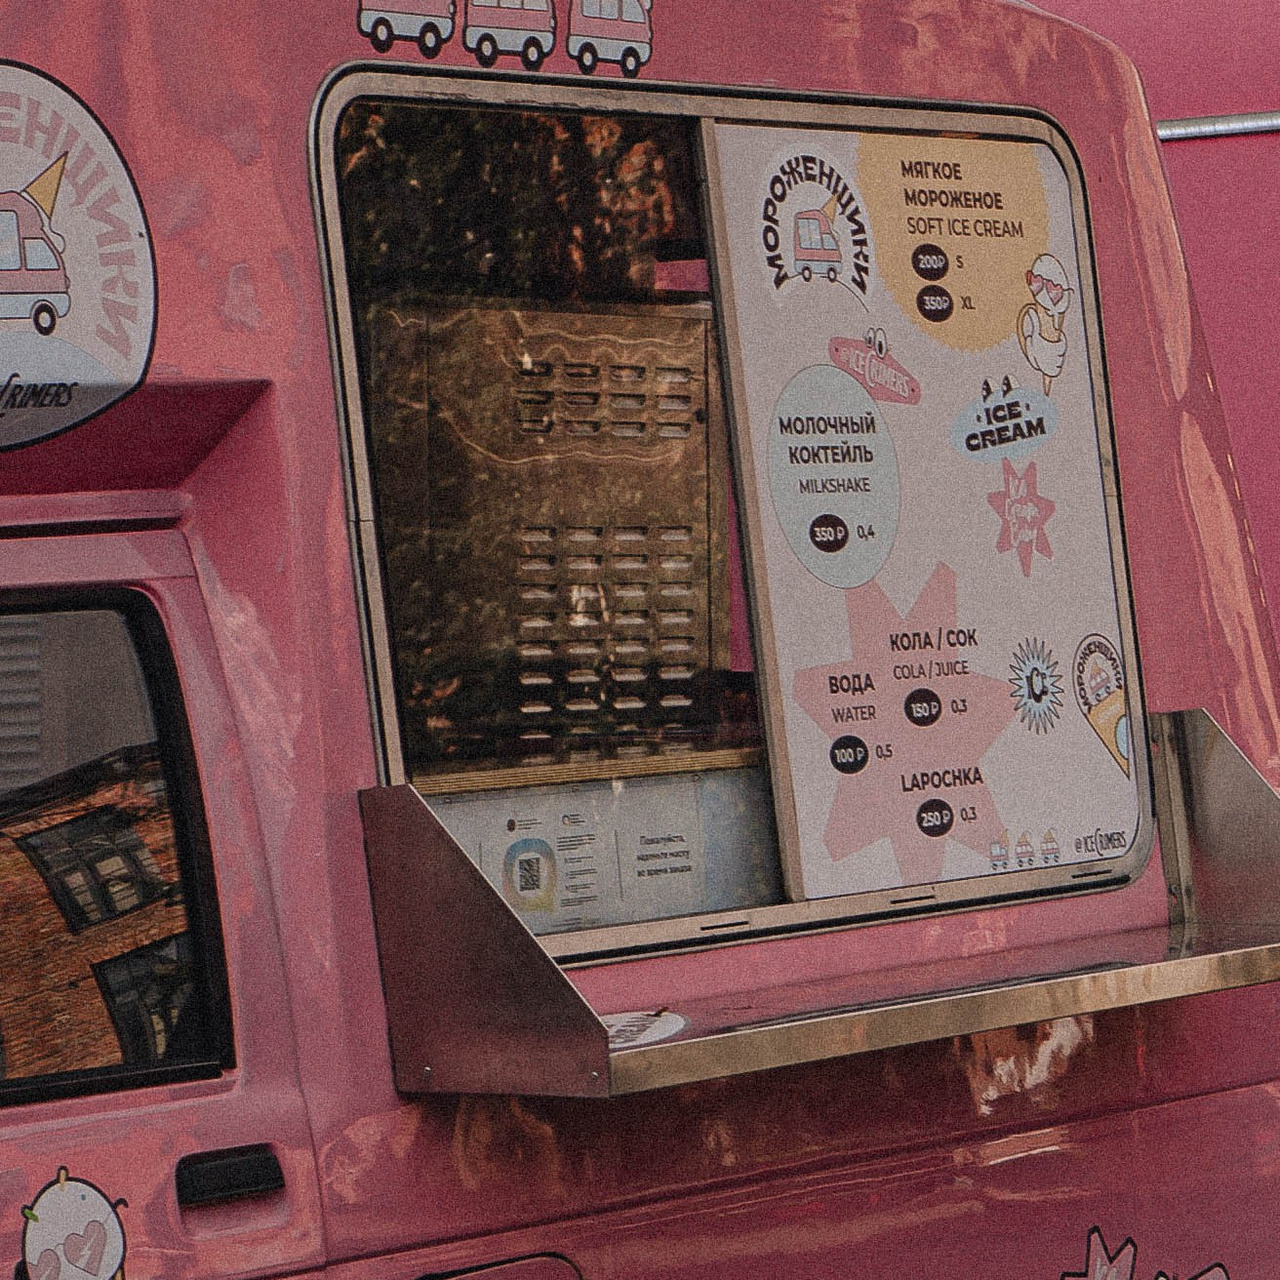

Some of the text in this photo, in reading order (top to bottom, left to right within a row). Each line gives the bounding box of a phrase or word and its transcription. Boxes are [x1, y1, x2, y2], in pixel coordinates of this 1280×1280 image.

[901, 160, 963, 180] МЯГКОЕ
[904, 188, 1004, 210] МОРОЖЕНОЕ
[762, 154, 870, 296] МОРОЖЕНЩИКИ
[907, 217, 1024, 238] SOFT ICE CREAM
[955, 255, 964, 269] S
[960, 296, 976, 310] XL
[779, 411, 876, 435] МОЛОЧНЫЙ
[983, 401, 1022, 425] ICE
[965, 417, 1046, 451] CREAM
[788, 440, 874, 464] КОКТЕЙЛЬ
[799, 477, 871, 494] MILKSHAKE
[856, 524, 876, 542] 0,4
[889, 632, 934, 651] КОЛА
[947, 628, 978, 648] СОК
[828, 673, 875, 696] ВОДА
[831, 705, 877, 723] WATER
[901, 767, 983, 793] LAPOCHKA
